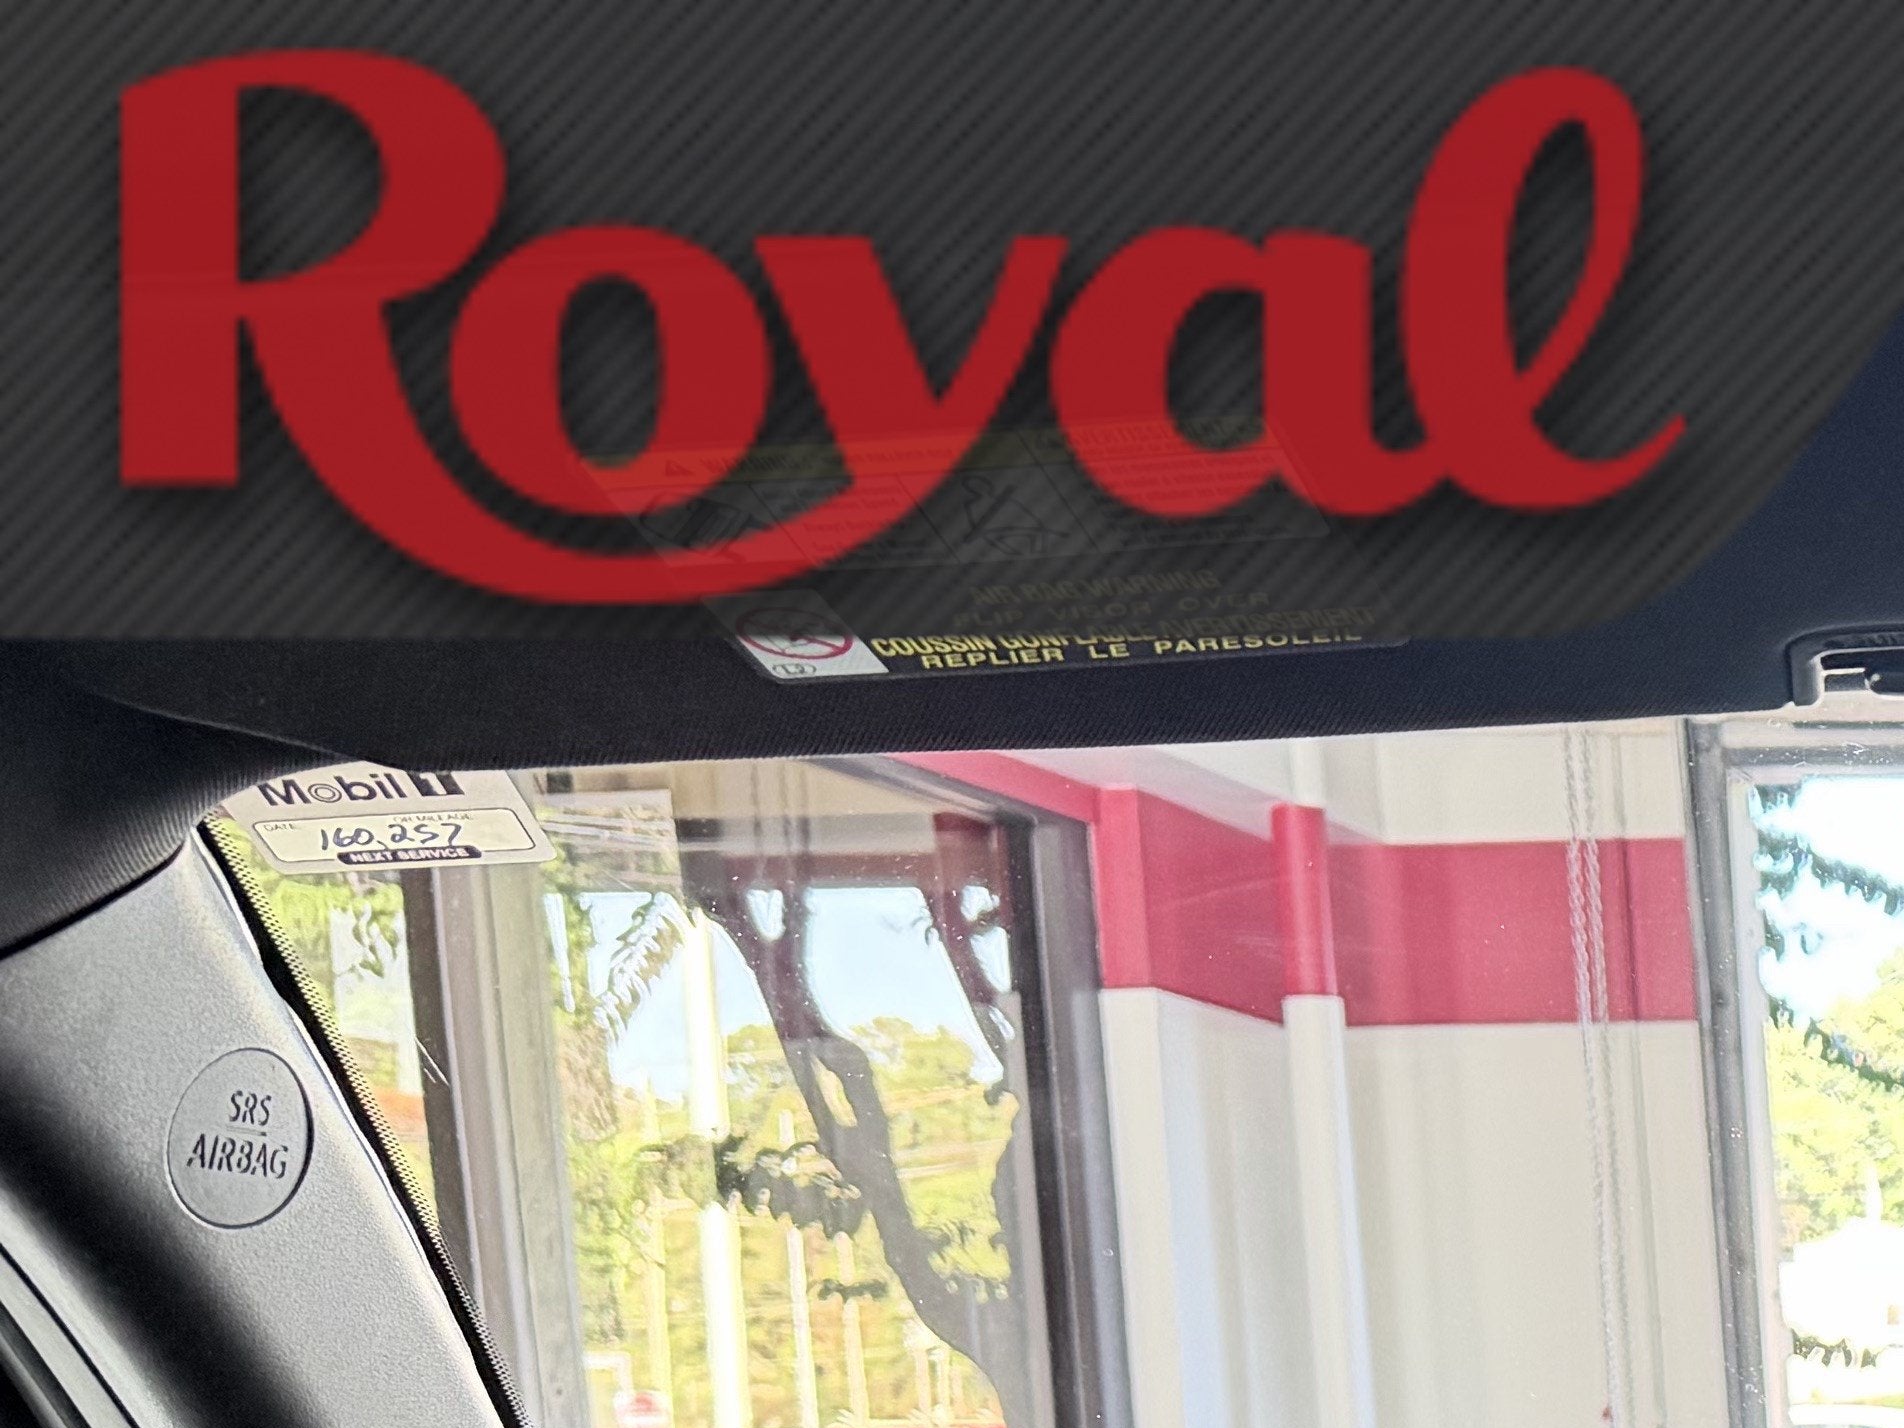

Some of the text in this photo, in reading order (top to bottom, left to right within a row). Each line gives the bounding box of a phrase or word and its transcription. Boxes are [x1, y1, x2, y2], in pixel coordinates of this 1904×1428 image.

[871, 635, 996, 658] COUSSIN
[921, 629, 1363, 670] REPLIER LE PARESOLEIL
[256, 772, 408, 807] Mobil
[351, 847, 470, 863] NEXT SERVICE
[229, 1090, 272, 1126] SRS
[186, 1133, 289, 1179] AIRBAG
